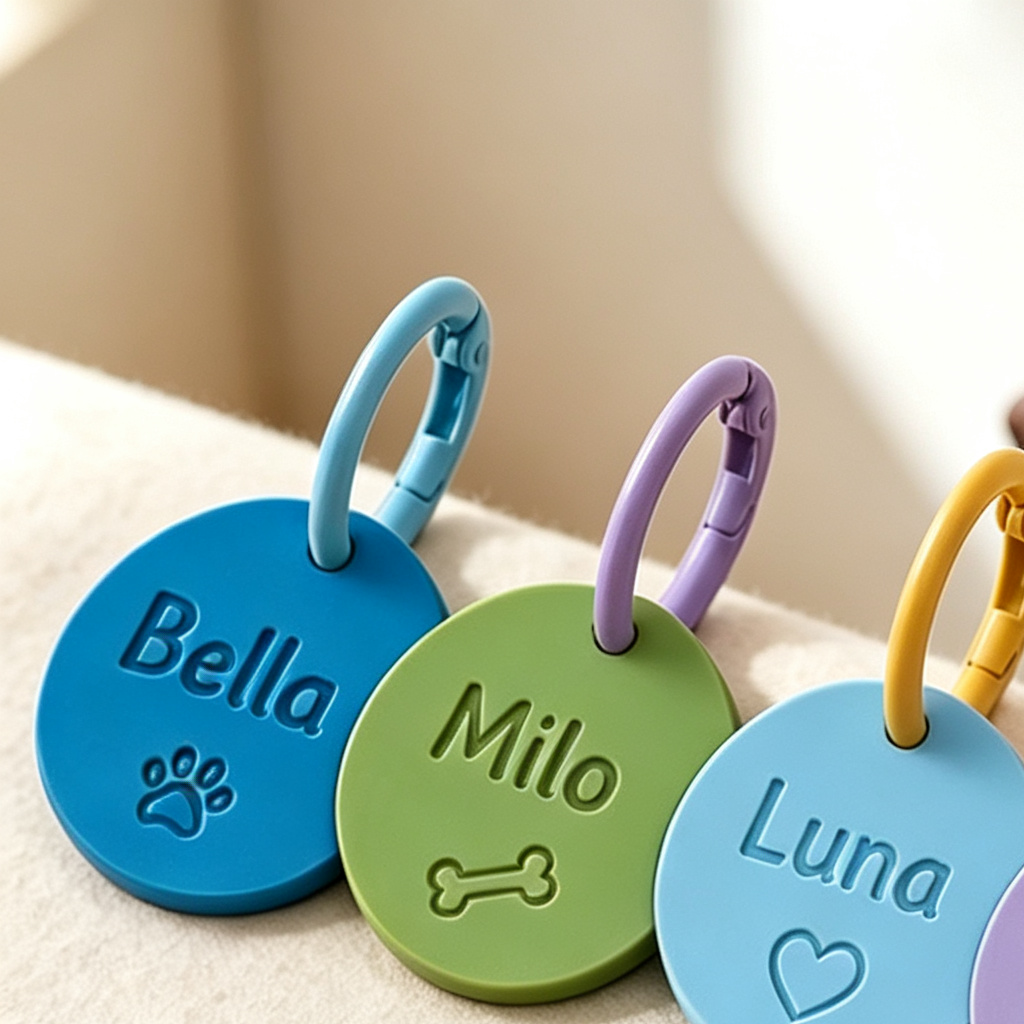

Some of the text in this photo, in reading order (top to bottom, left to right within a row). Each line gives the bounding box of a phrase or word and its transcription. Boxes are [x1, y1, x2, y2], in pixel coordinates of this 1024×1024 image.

[118, 590, 340, 737] Bella
[430, 682, 620, 812] Milo
[739, 777, 952, 918] Luna
